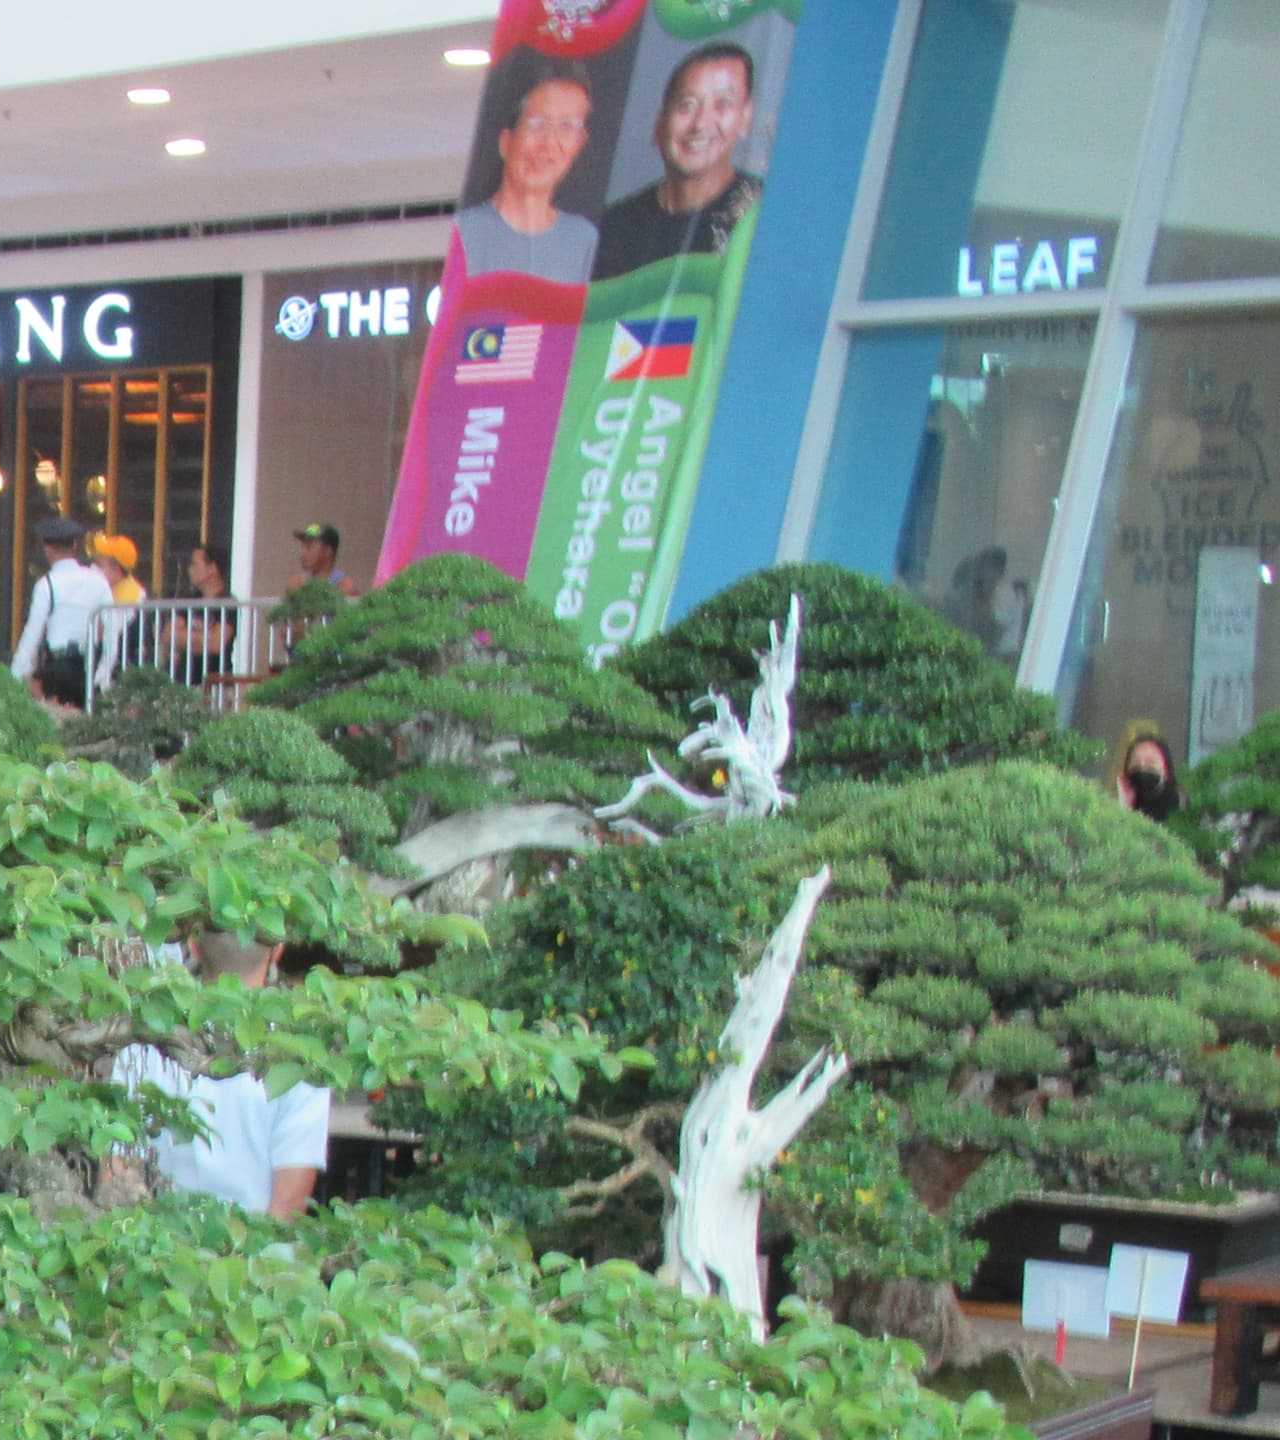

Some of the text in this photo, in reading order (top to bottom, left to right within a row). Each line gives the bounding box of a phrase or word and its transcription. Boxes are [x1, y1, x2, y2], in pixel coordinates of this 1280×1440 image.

[319, 286, 410, 338] THE
[957, 237, 1098, 297] LEAF
[445, 406, 505, 537] Mike
[554, 397, 637, 619] Uyehara
[618, 395, 683, 552] Angel
